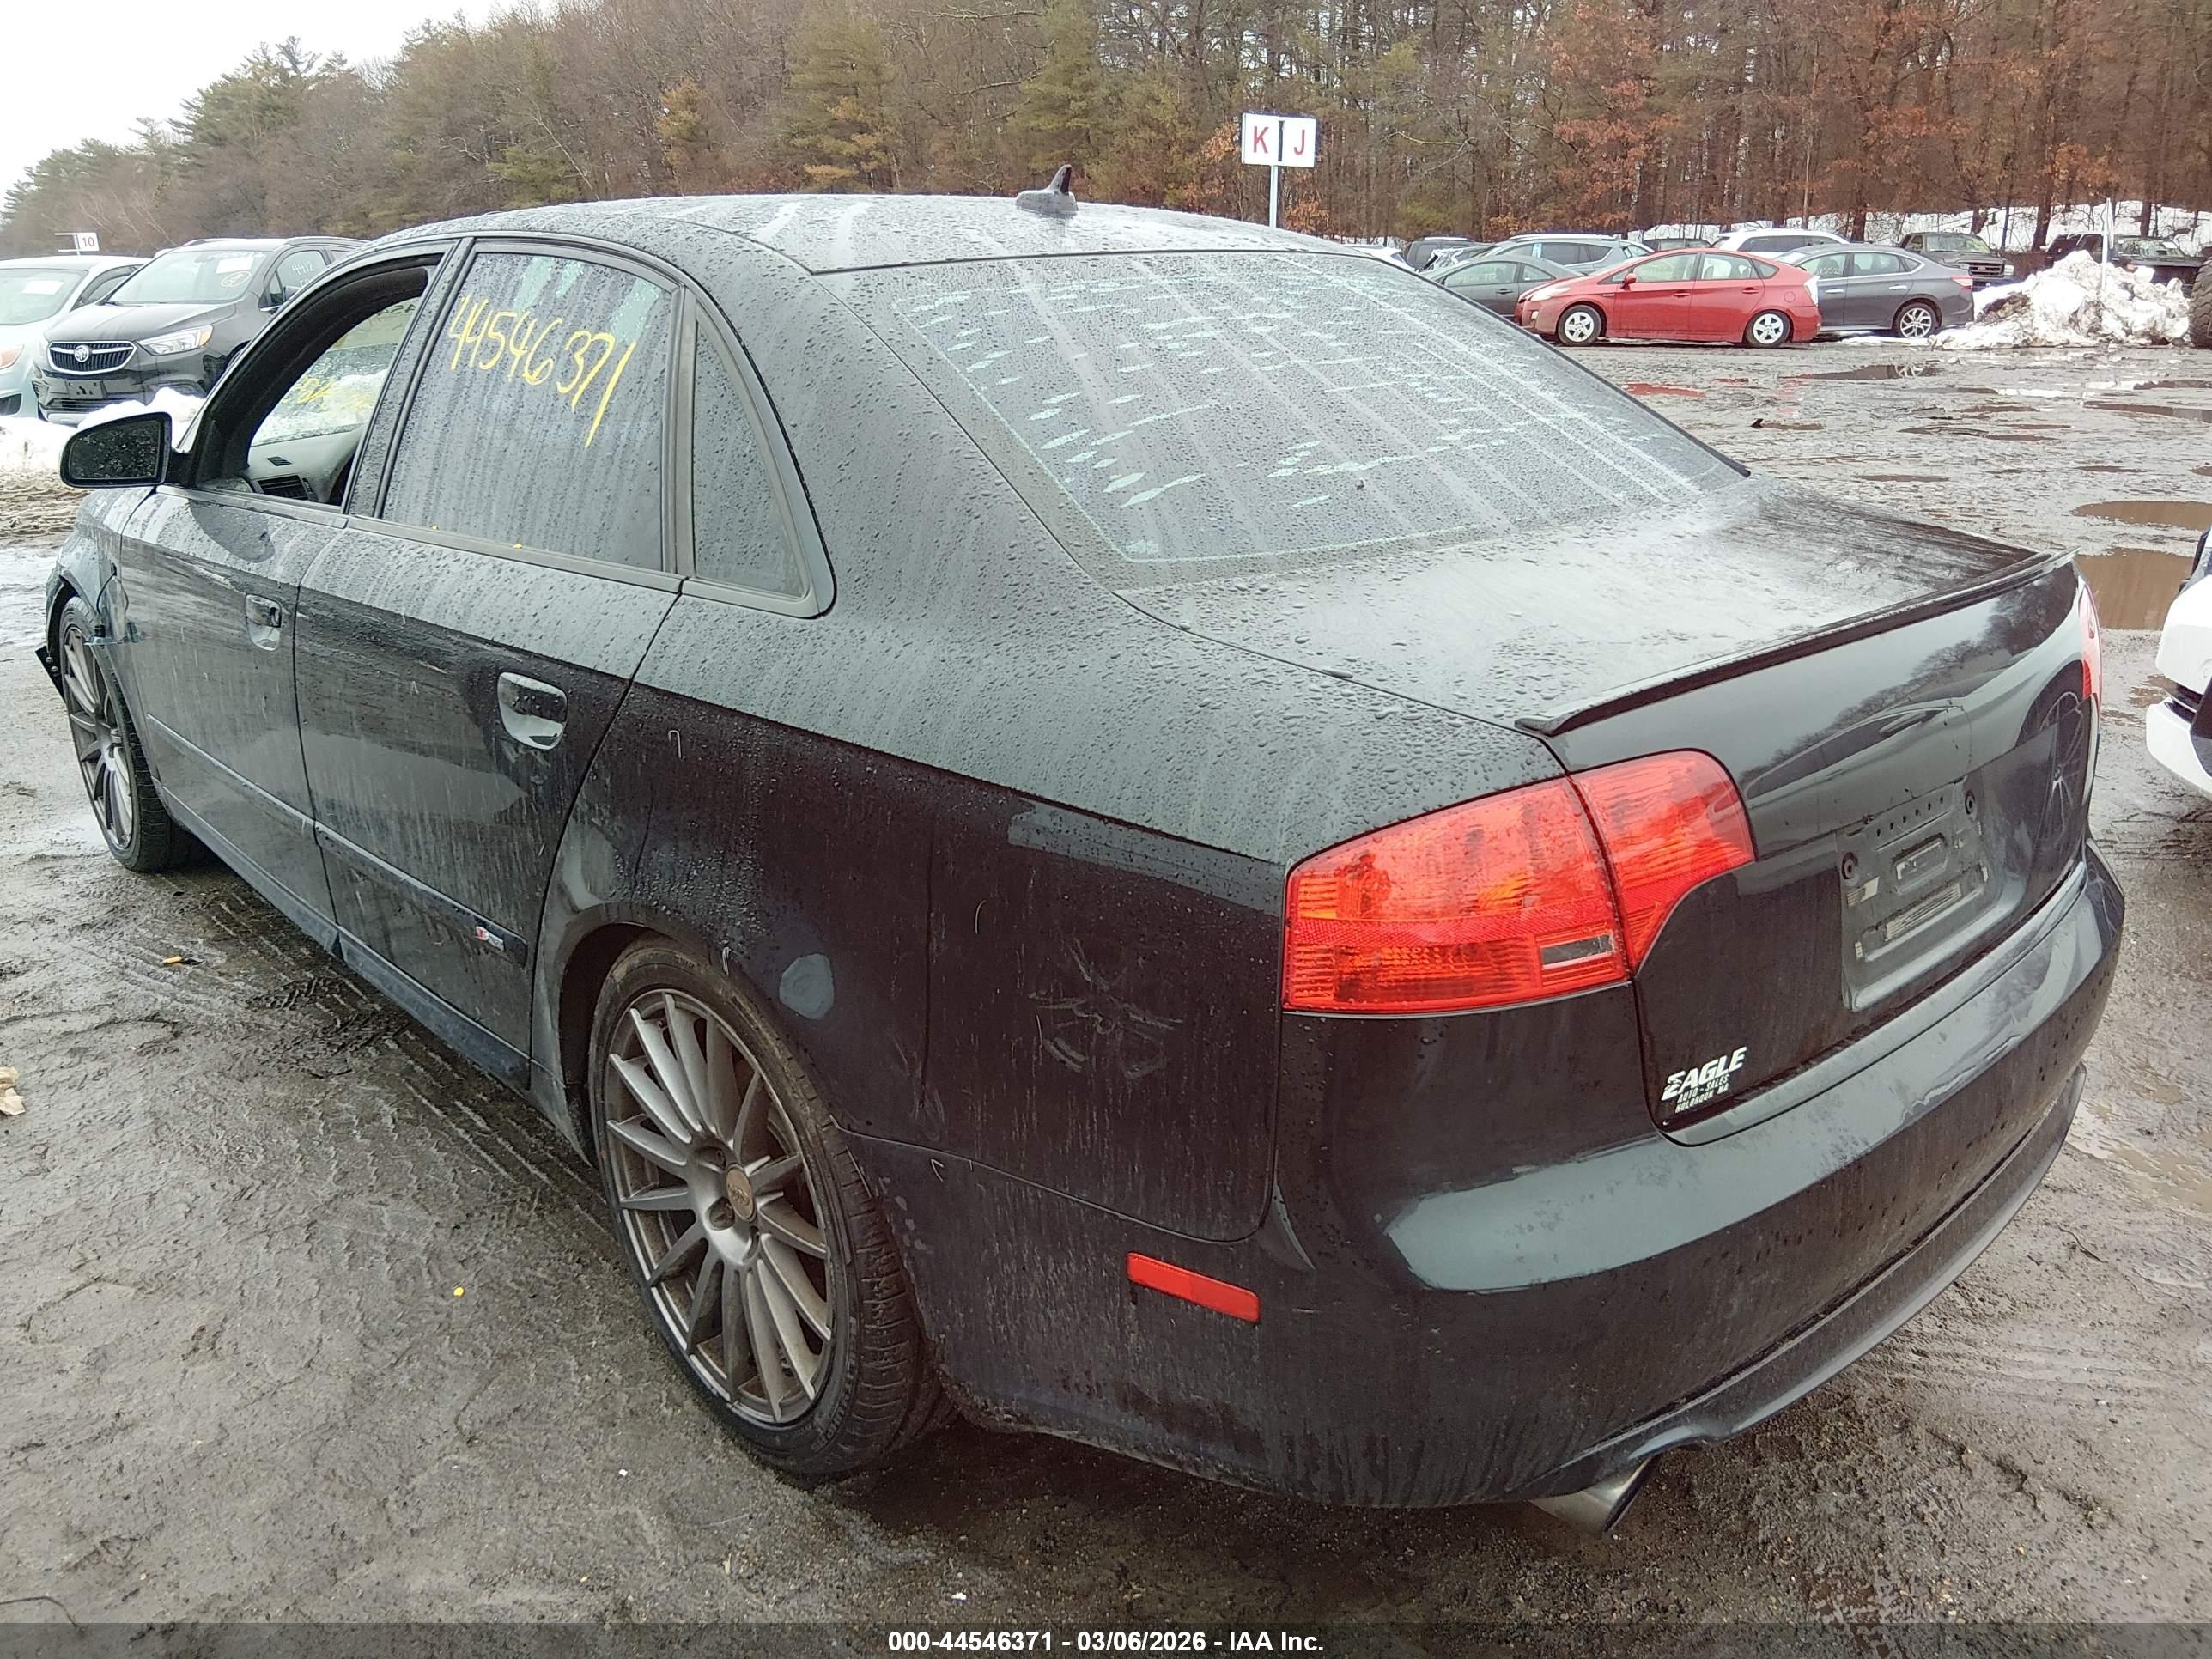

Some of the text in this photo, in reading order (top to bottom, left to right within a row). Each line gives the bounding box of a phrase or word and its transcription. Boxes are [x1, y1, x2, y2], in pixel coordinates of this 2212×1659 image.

[1253, 125, 1306, 156] K J
[81, 236, 94, 247] 10
[1661, 1046, 1748, 1101] EAGLE
